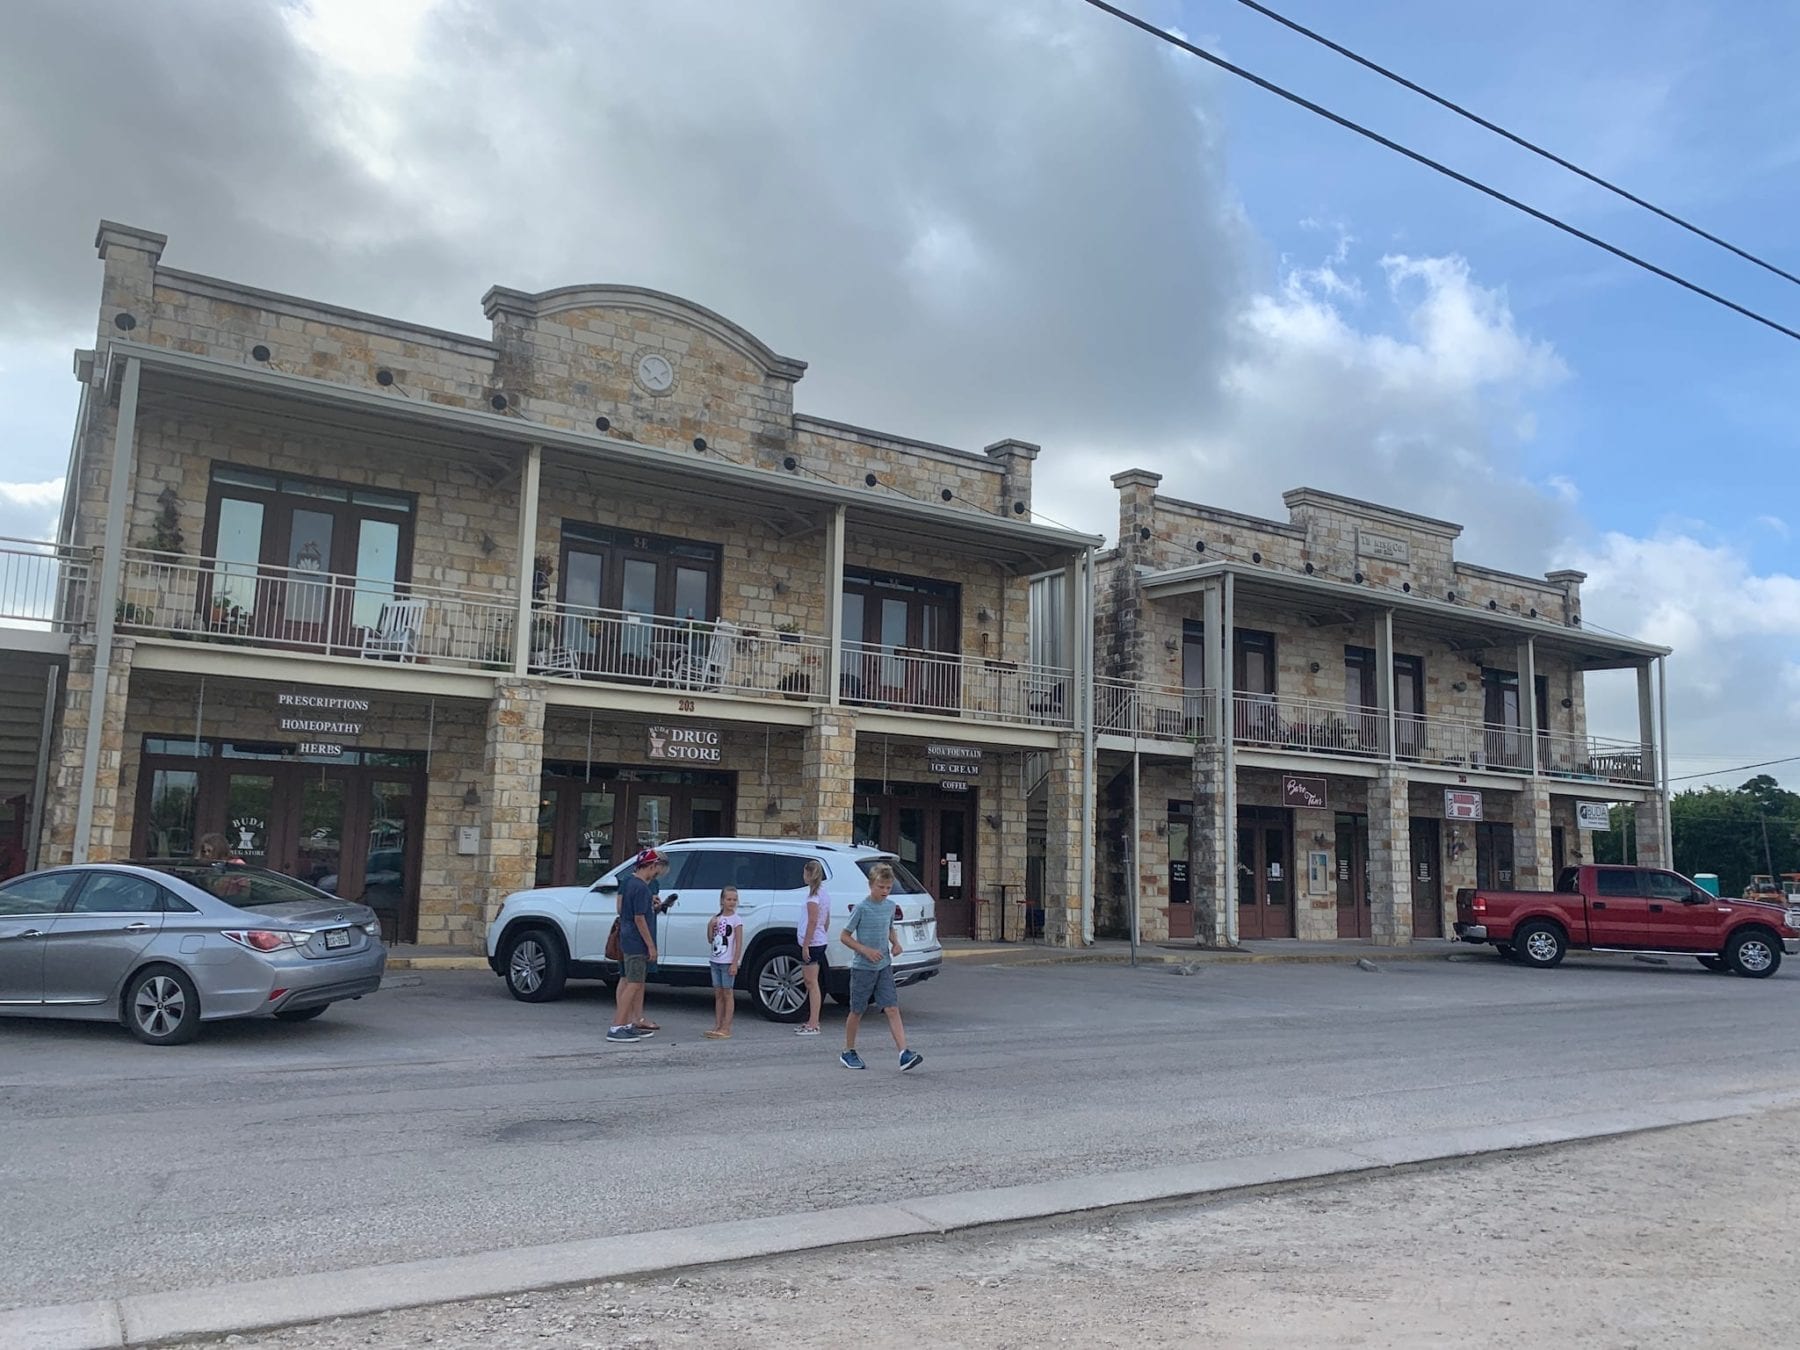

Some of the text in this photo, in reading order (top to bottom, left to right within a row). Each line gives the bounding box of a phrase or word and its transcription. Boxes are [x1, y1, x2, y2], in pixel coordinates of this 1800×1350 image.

[279, 694, 369, 711] PRESCRIPTIONS
[678, 700, 695, 712] 203
[281, 719, 361, 734] HOMEOPATHY
[672, 729, 719, 745] DRUG
[300, 743, 341, 755] HERBS
[667, 745, 720, 761] STORE
[927, 746, 981, 758] SODA FOUNTAIN
[931, 763, 979, 774] ICE CREAM
[942, 780, 967, 790] COFFEE
[1587, 805, 1608, 817] BUDA
[232, 817, 265, 829] BUDA
[583, 830, 609, 840] BUDA
